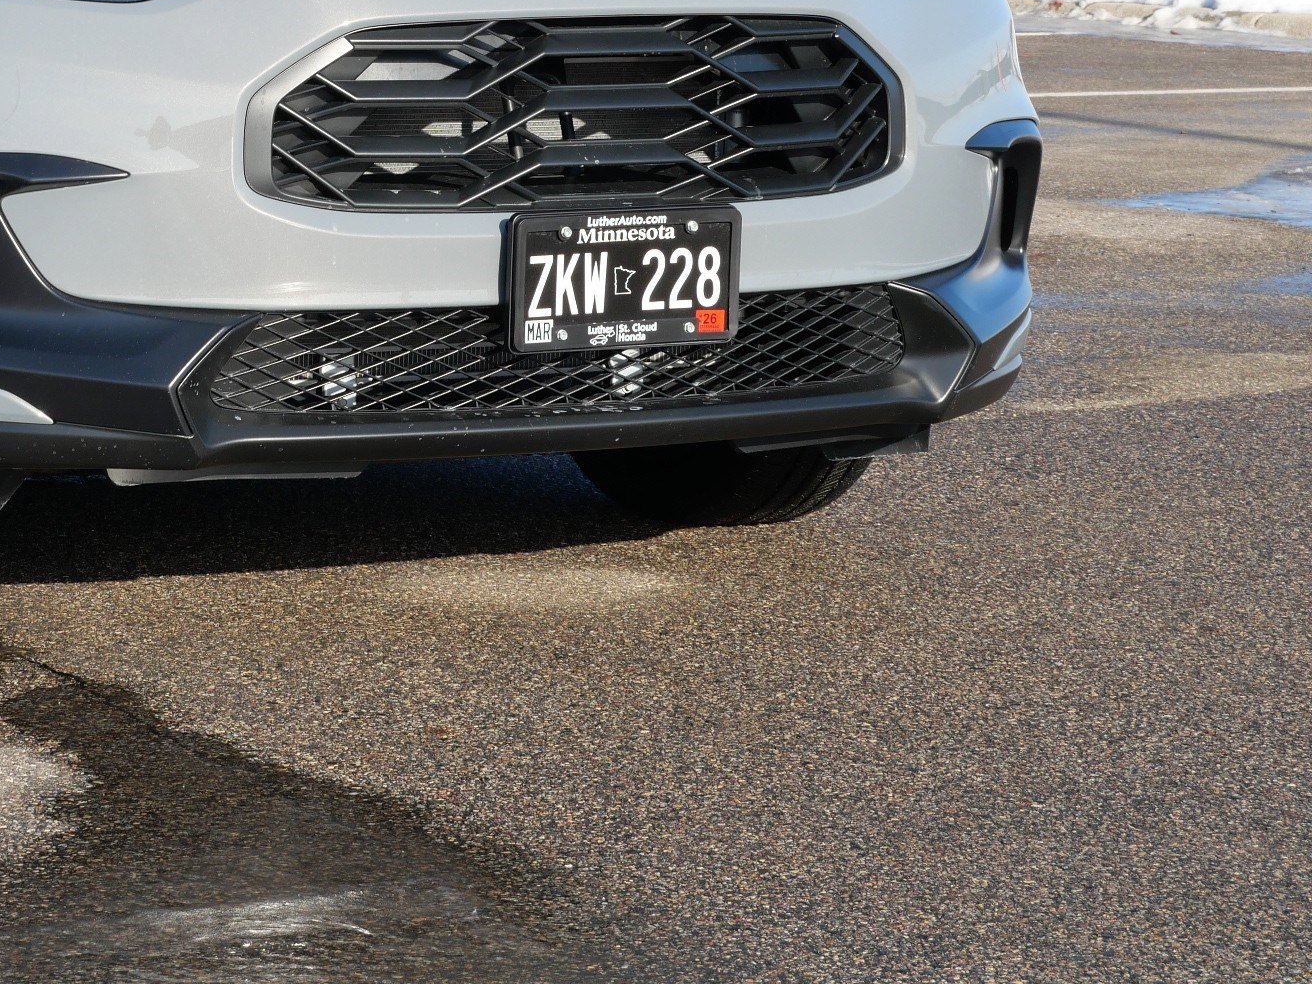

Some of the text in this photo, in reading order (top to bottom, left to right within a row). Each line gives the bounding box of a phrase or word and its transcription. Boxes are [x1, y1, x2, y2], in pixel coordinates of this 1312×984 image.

[587, 215, 668, 227] LutherAuto.com
[577, 224, 676, 245] Minnesota
[527, 245, 721, 318] ZKW 228
[703, 313, 717, 324] 26
[527, 322, 551, 341] MAR
[618, 323, 631, 333] St.
[632, 321, 658, 333] Cloud
[618, 332, 646, 342] Honda
